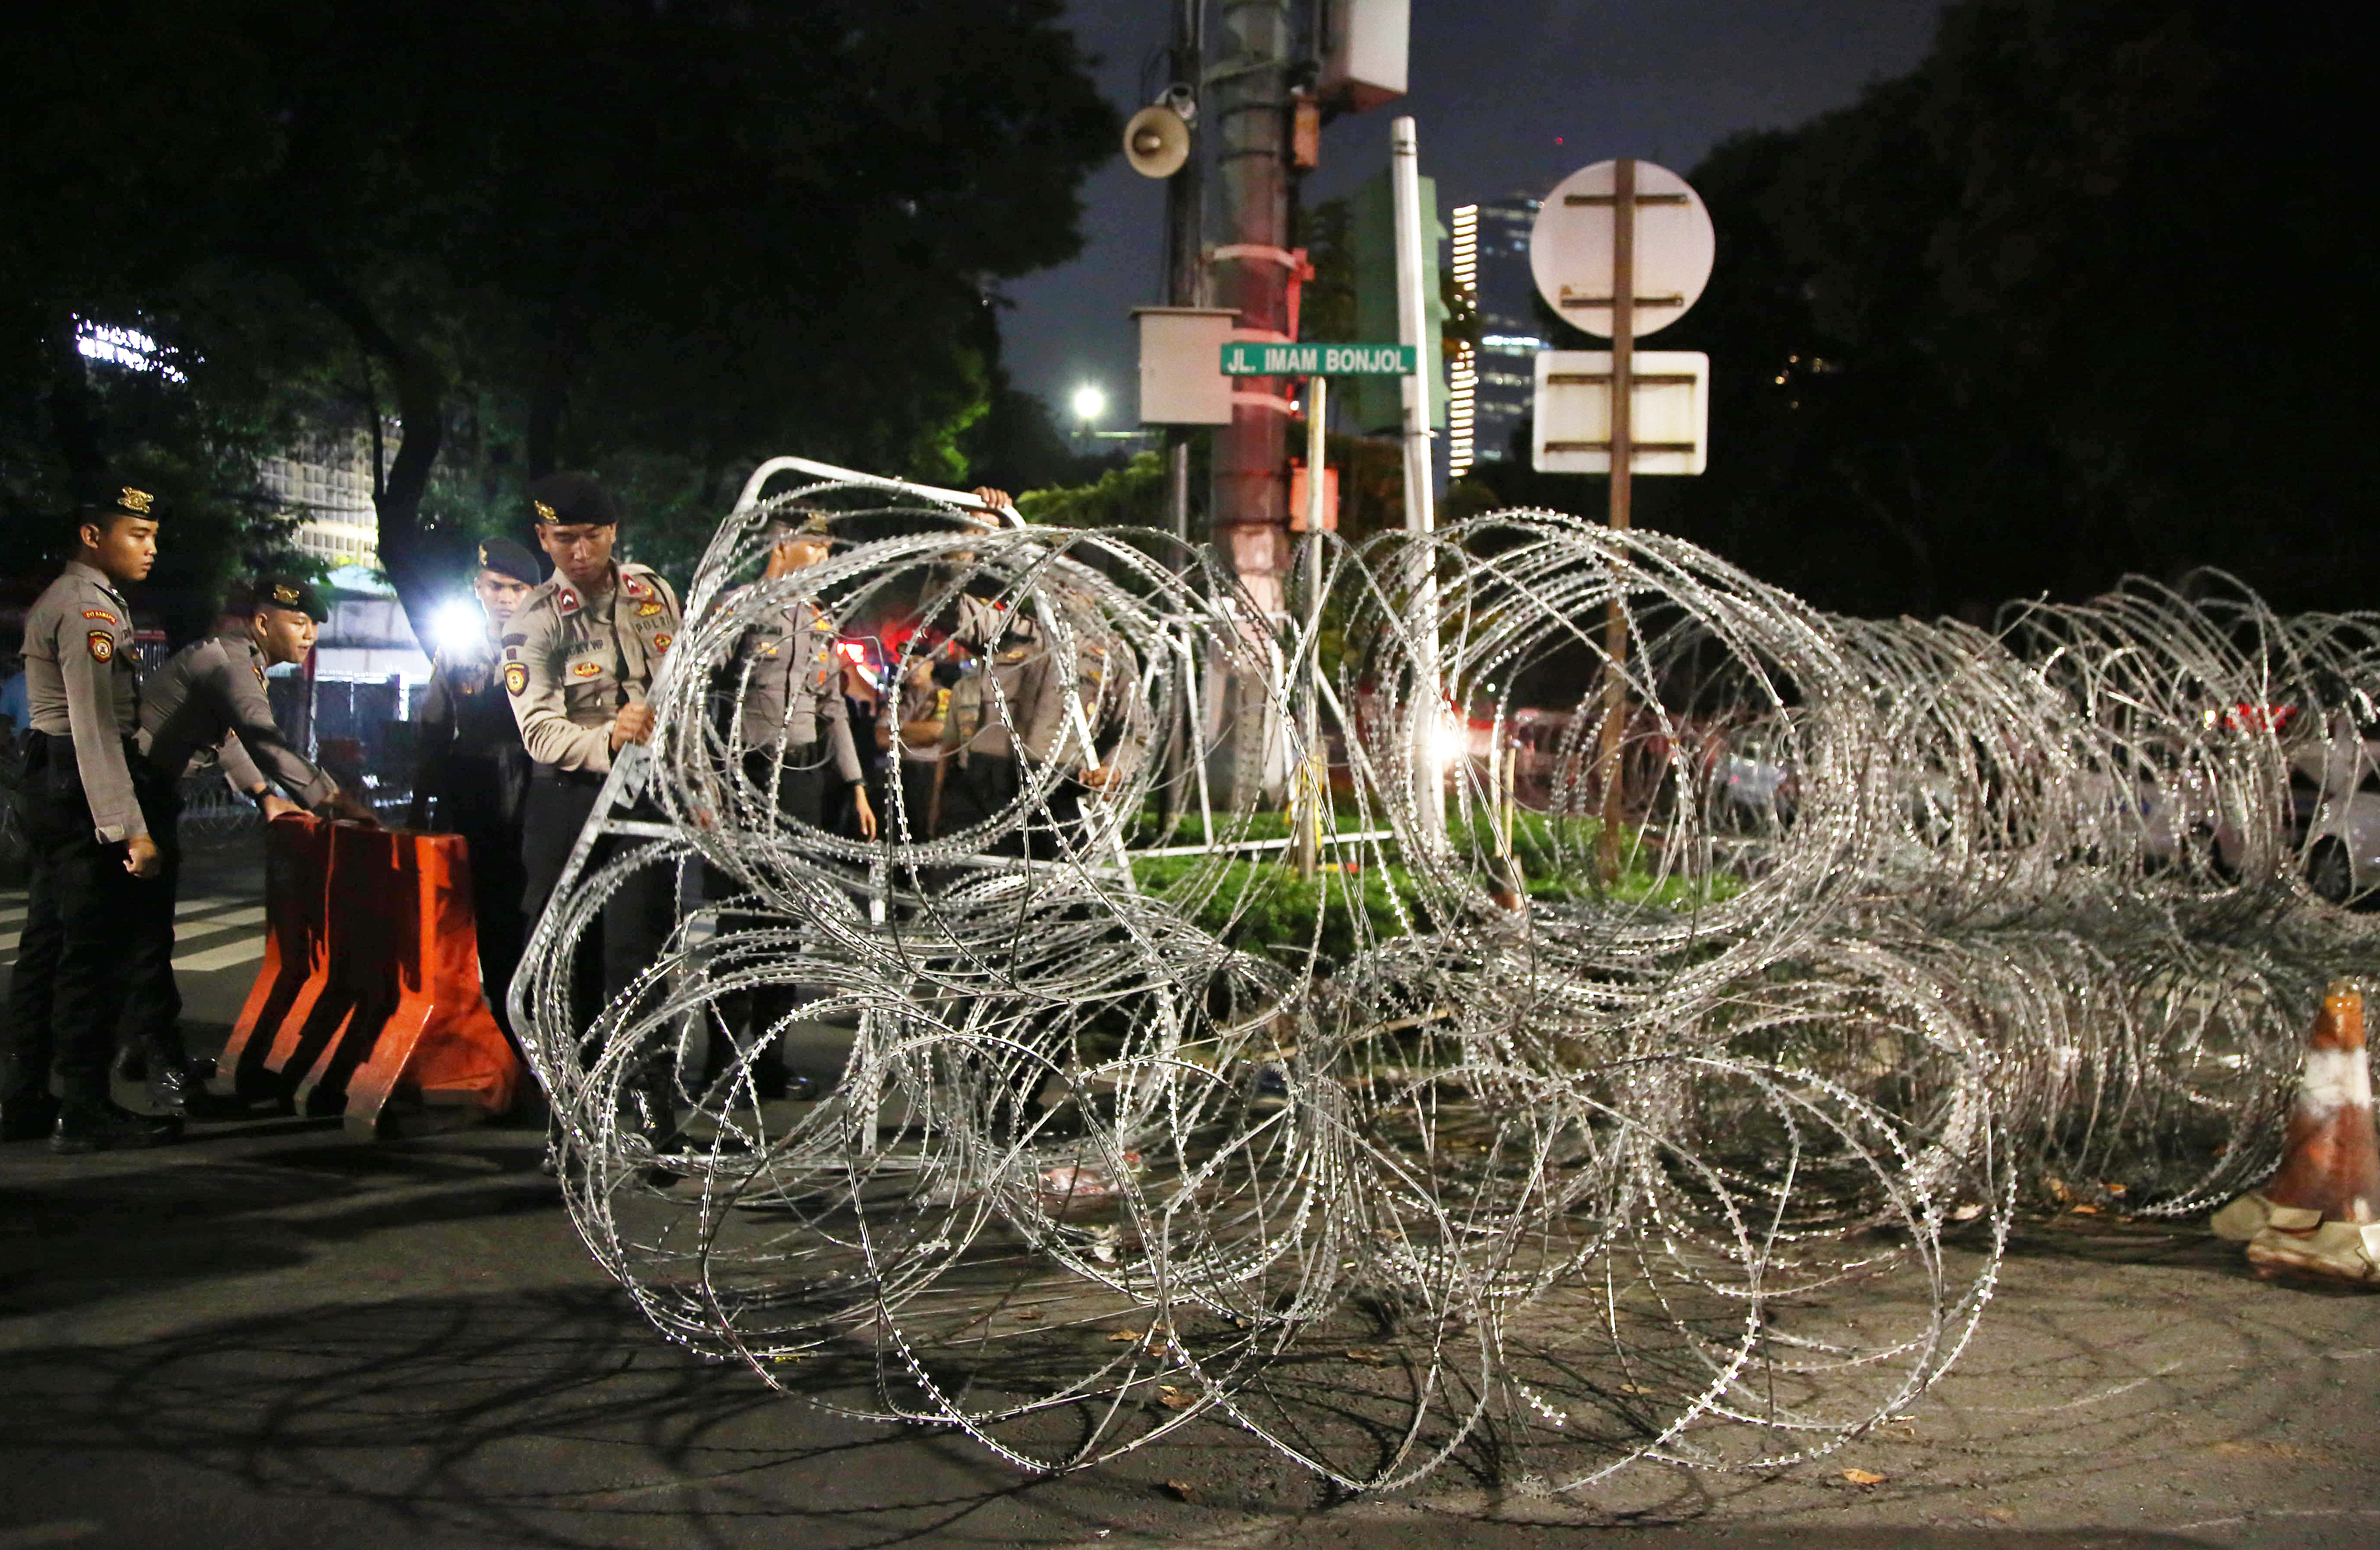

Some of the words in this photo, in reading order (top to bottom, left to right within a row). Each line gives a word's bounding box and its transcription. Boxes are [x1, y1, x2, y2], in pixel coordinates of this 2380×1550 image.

[1228, 348, 1256, 372] JL.
[1265, 348, 1317, 372] IMAM
[1326, 349, 1408, 372] BONJOL
[635, 615, 669, 633] POLRI
